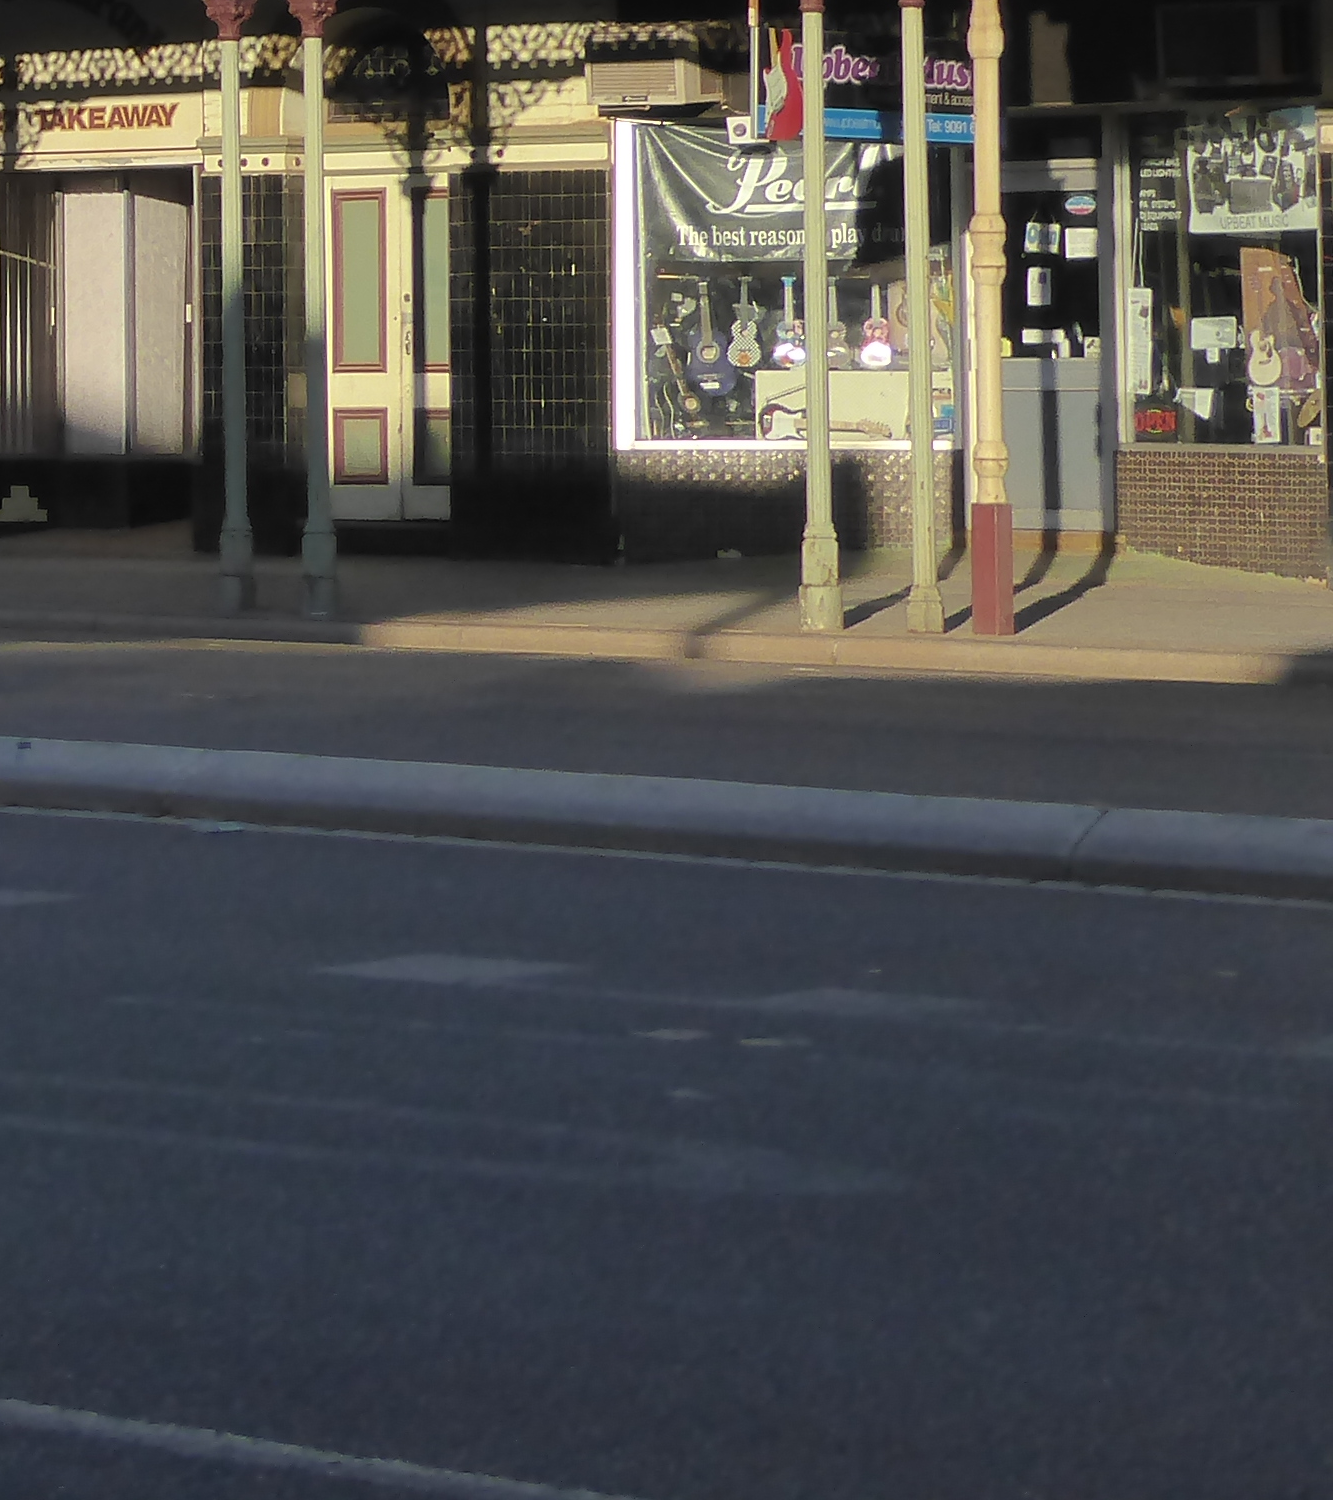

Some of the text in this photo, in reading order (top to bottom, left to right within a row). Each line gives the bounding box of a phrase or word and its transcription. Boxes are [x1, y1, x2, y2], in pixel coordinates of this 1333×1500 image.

[34, 102, 182, 132] TAKEAWAY
[1219, 213, 1290, 230] UPBEAT MUSIC
[676, 225, 709, 247] The
[712, 224, 746, 247] best
[749, 228, 805, 247] reason
[830, 222, 866, 250] play
